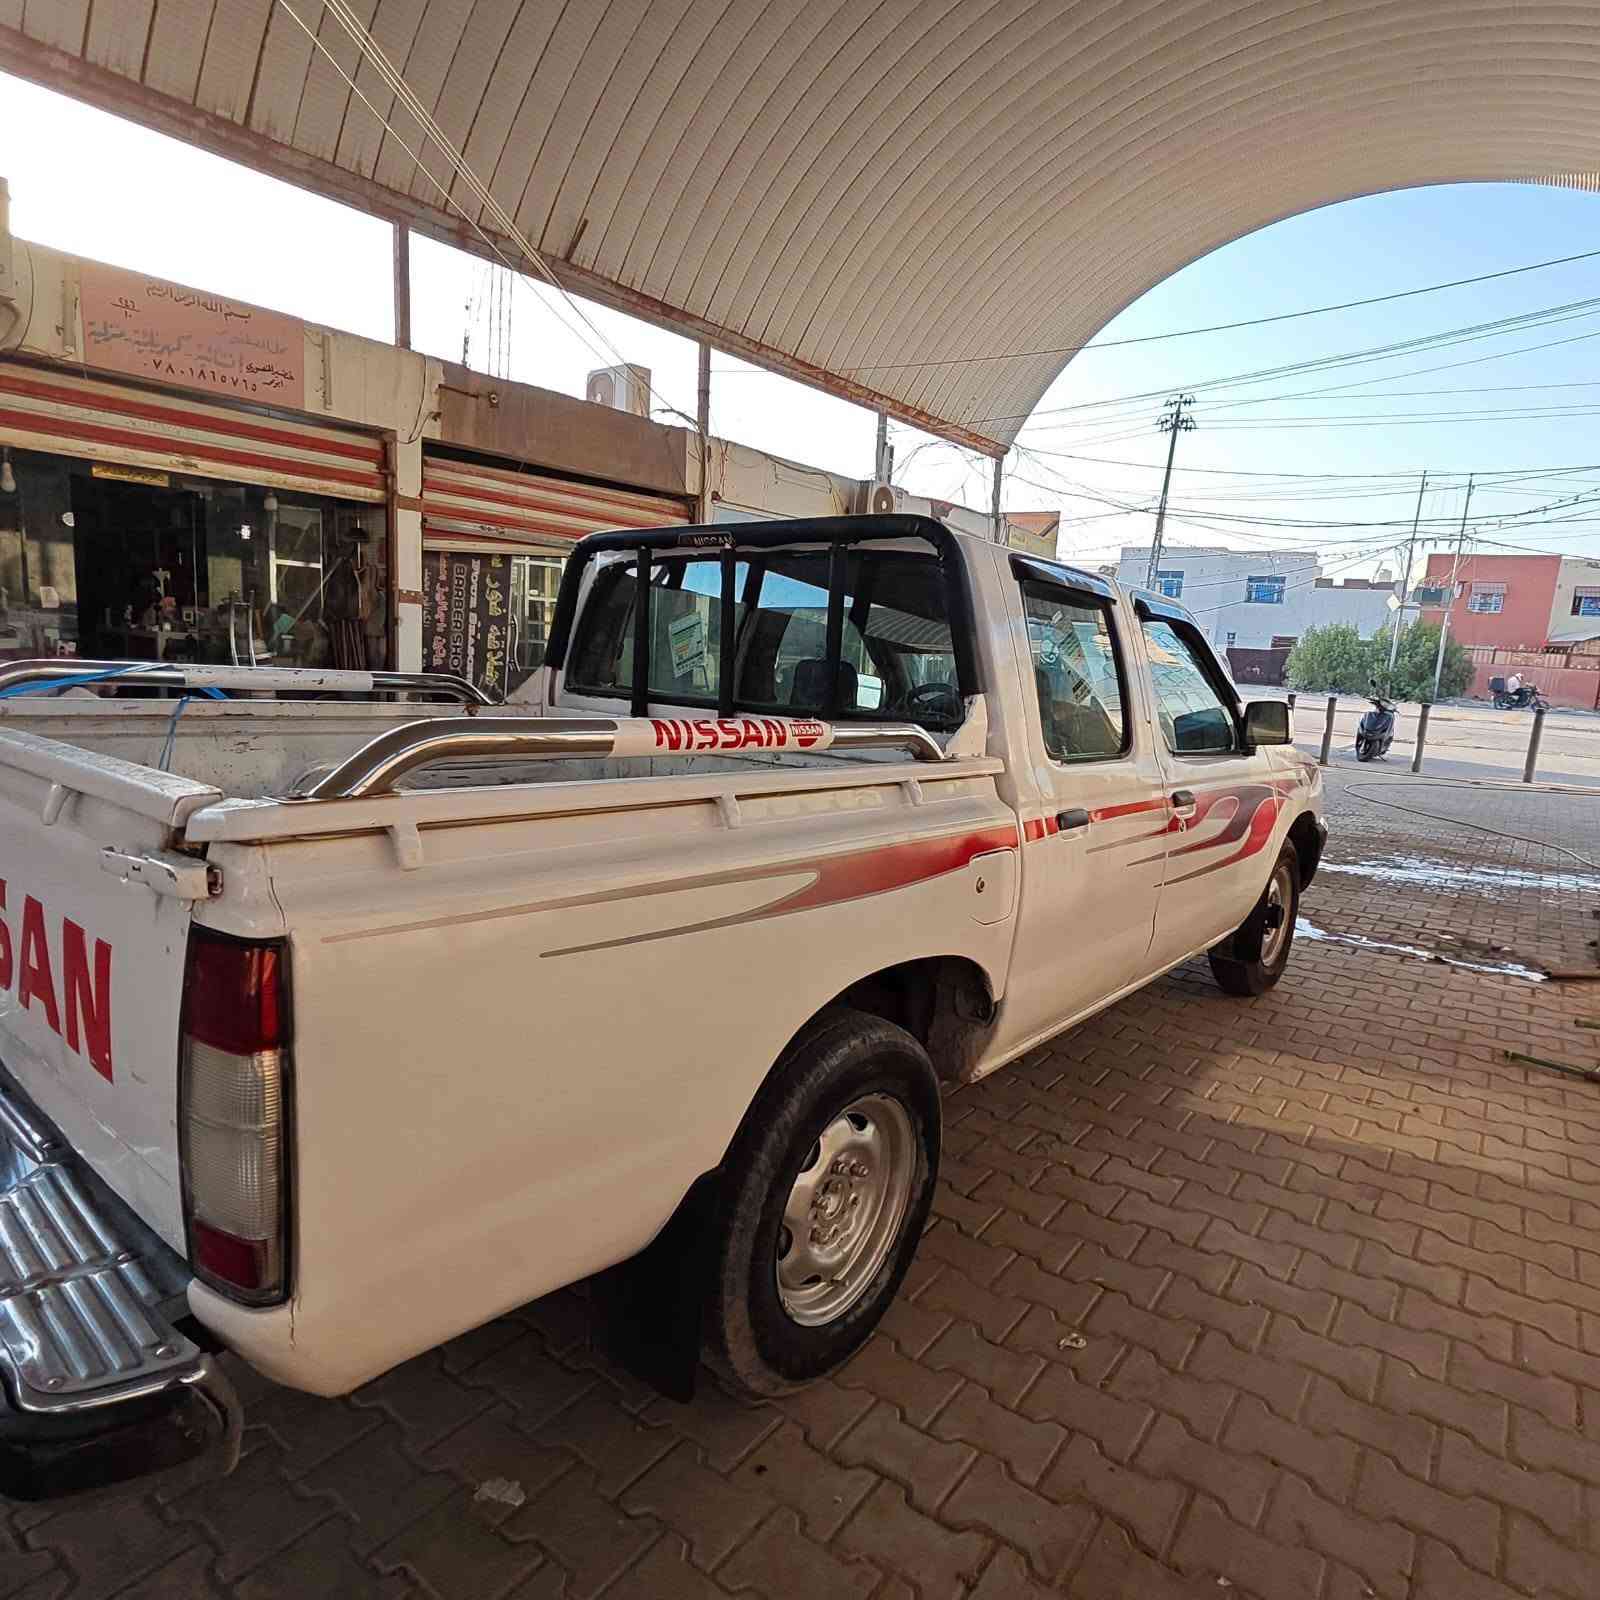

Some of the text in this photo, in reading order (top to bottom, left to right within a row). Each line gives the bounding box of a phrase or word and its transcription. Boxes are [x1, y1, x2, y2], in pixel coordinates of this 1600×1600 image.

[201, 299, 223, 313] الله
[224, 303, 251, 323] بسم
[449, 563, 467, 674] BARBER SHO
[650, 719, 787, 750] NISSAN
[790, 724, 824, 737] NISSAN
